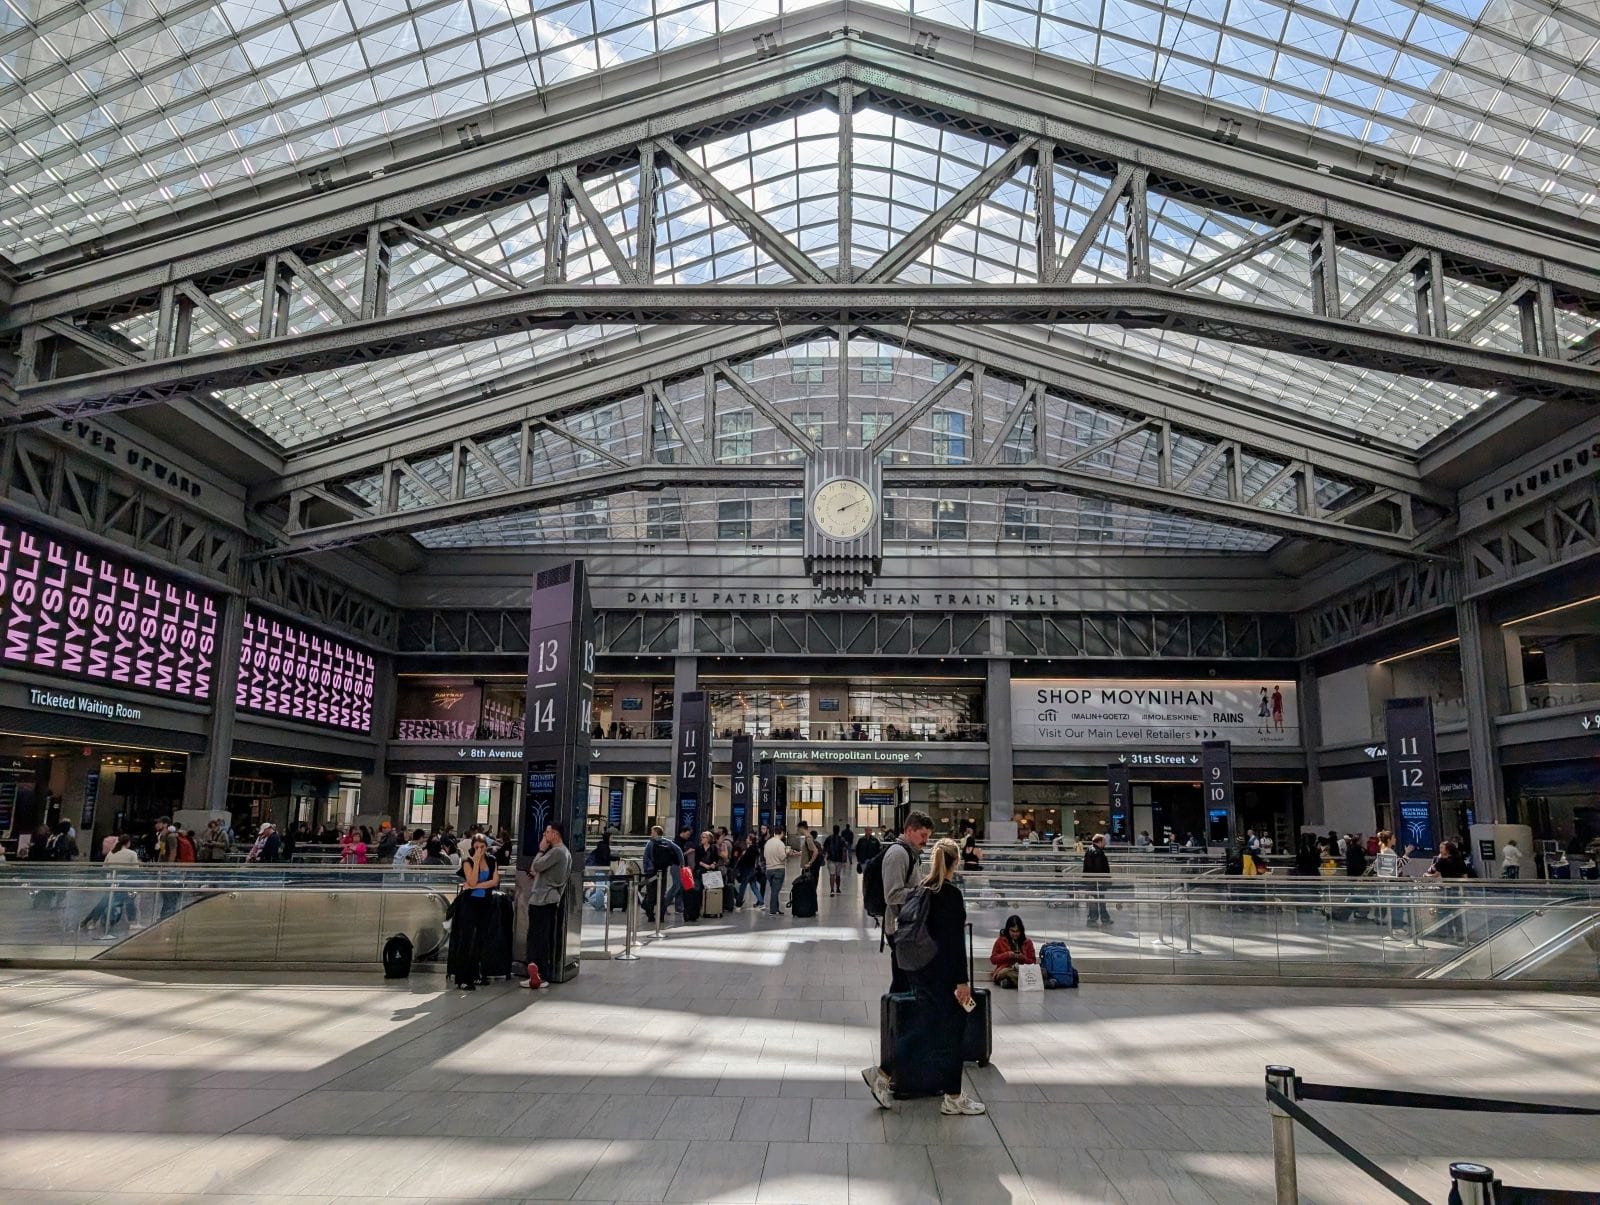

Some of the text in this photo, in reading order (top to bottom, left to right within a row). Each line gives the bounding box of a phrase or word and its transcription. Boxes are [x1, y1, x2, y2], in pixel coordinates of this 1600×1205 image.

[62, 419, 202, 497] EVER UPWARD
[5, 531, 41, 661] MYSLF
[34, 541, 68, 667] MYSLF
[62, 551, 94, 673] MYSLF
[627, 592, 698, 604] DANIEL
[713, 593, 799, 604] PATRICK
[935, 593, 996, 605] TRAIN
[1010, 594, 1059, 605] HALL
[88, 560, 118, 677] MYSLF
[112, 568, 140, 682] MYSLF
[134, 576, 161, 687] MYSLF
[155, 583, 181, 690] MYSLF
[176, 590, 200, 694] MYSLF
[195, 597, 217, 698] MYSLF
[236, 611, 254, 705] MYSLF
[249, 616, 269, 709] MYSLF
[264, 621, 283, 712] MYSLF
[279, 626, 297, 715] MYSLF
[538, 639, 559, 673] 13
[584, 640, 594, 674] 13
[292, 631, 309, 717] MYSLF
[305, 635, 321, 720] MYSLF
[317, 640, 333, 722] MYSLF
[329, 644, 344, 724] MYSLF
[340, 648, 355, 727] MYSLF
[351, 652, 365, 729] MYSLF
[31, 689, 141, 719] Ticketed Waiting Room
[361, 655, 375, 731] MYSLF
[1037, 689, 1214, 706] SHOP MOYNIHAN
[533, 698, 556, 733] 14
[581, 698, 591, 734] 14
[1038, 709, 1058, 722] citi
[1213, 713, 1244, 723] RAINS
[685, 730, 696, 747] 11
[1038, 728, 1191, 739] Visit Our Main Level Retailers
[1400, 737, 1418, 755] 11
[471, 749, 524, 758] 8th Avenue
[683, 761, 696, 778] 12
[737, 761, 743, 774] 9
[773, 750, 910, 762] Amtrak Metropolitan Lounge
[1131, 754, 1186, 764] 31st Street
[735, 782, 745, 794] 10
[763, 778, 769, 788] 7
[1114, 782, 1120, 792] 7
[1211, 767, 1221, 780] 9
[1401, 768, 1424, 787] 12
[763, 794, 768, 803] 8
[1115, 798, 1121, 807] 8
[1211, 788, 1224, 800] 10
